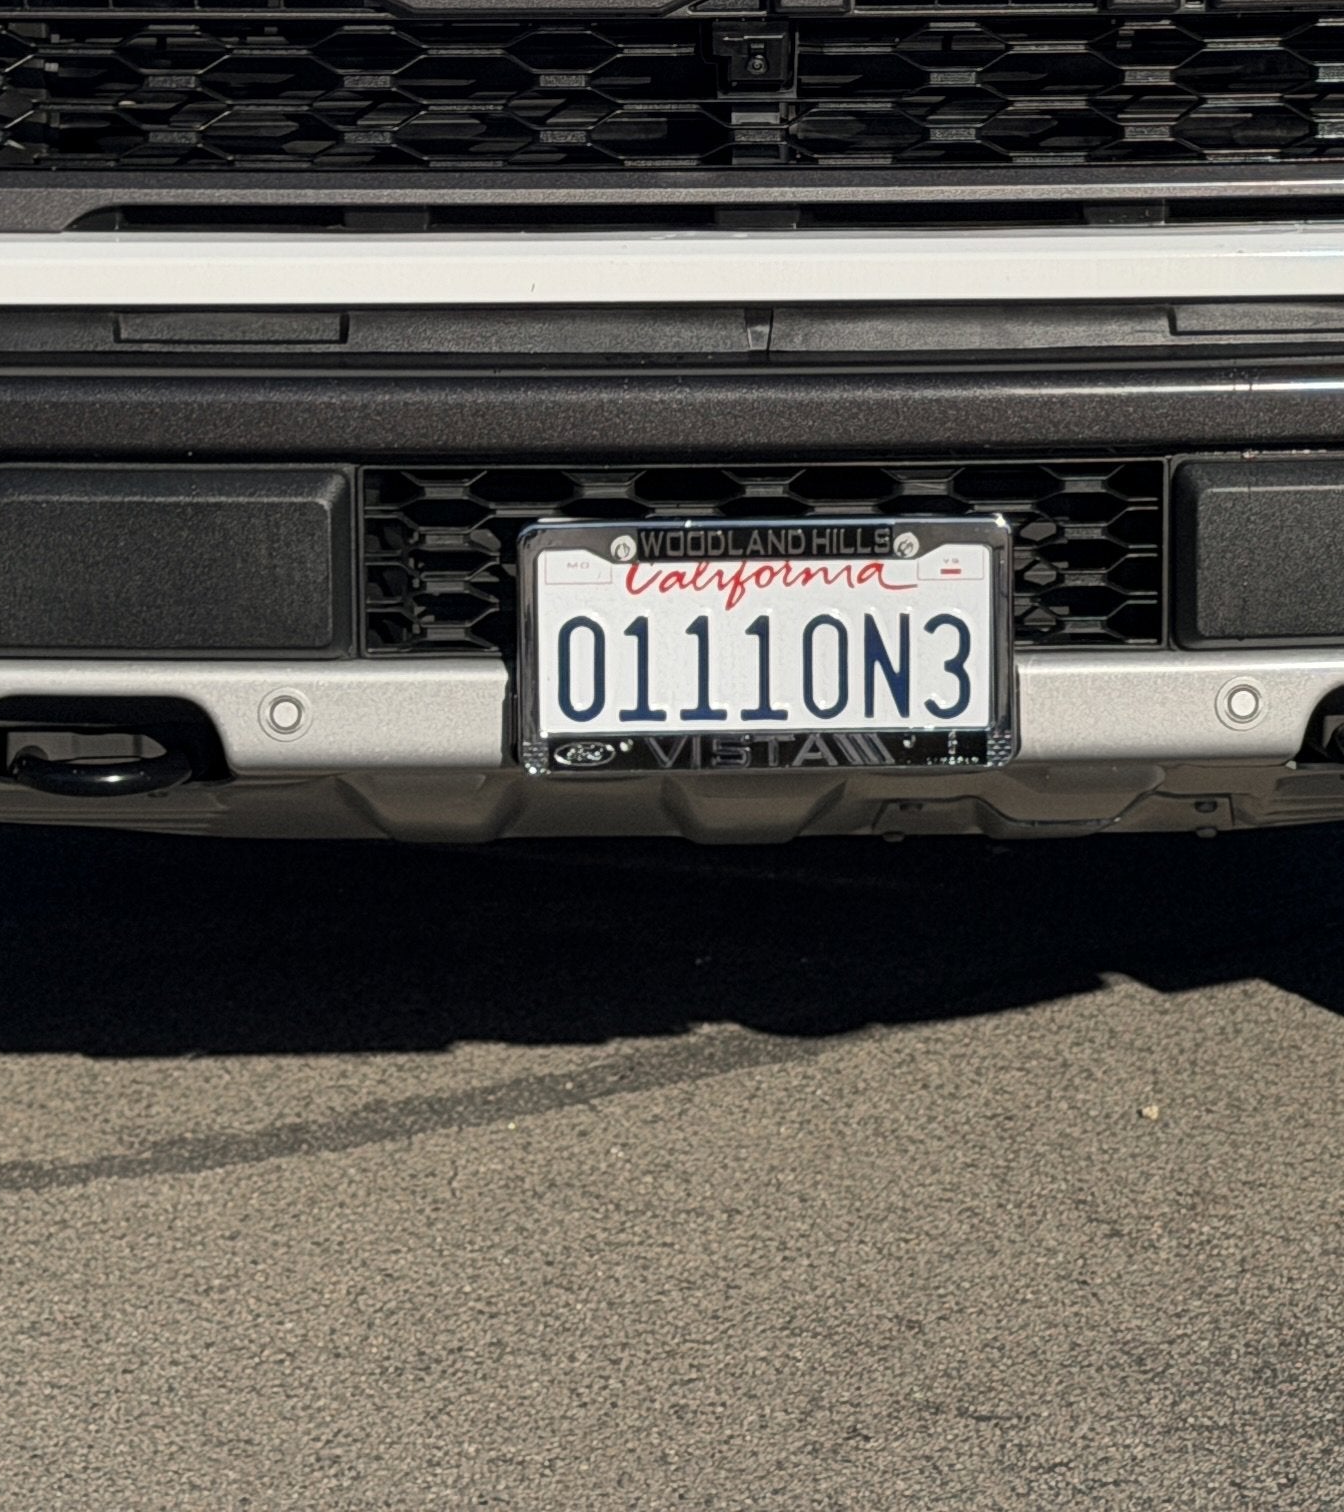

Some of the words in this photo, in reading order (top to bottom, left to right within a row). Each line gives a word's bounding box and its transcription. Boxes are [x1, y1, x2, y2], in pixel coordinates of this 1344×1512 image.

[640, 529, 806, 558] WOODLAND
[812, 528, 891, 555] HILLS
[625, 561, 919, 610] California
[557, 612, 972, 722] 01110N3
[645, 732, 839, 770] VISTA
